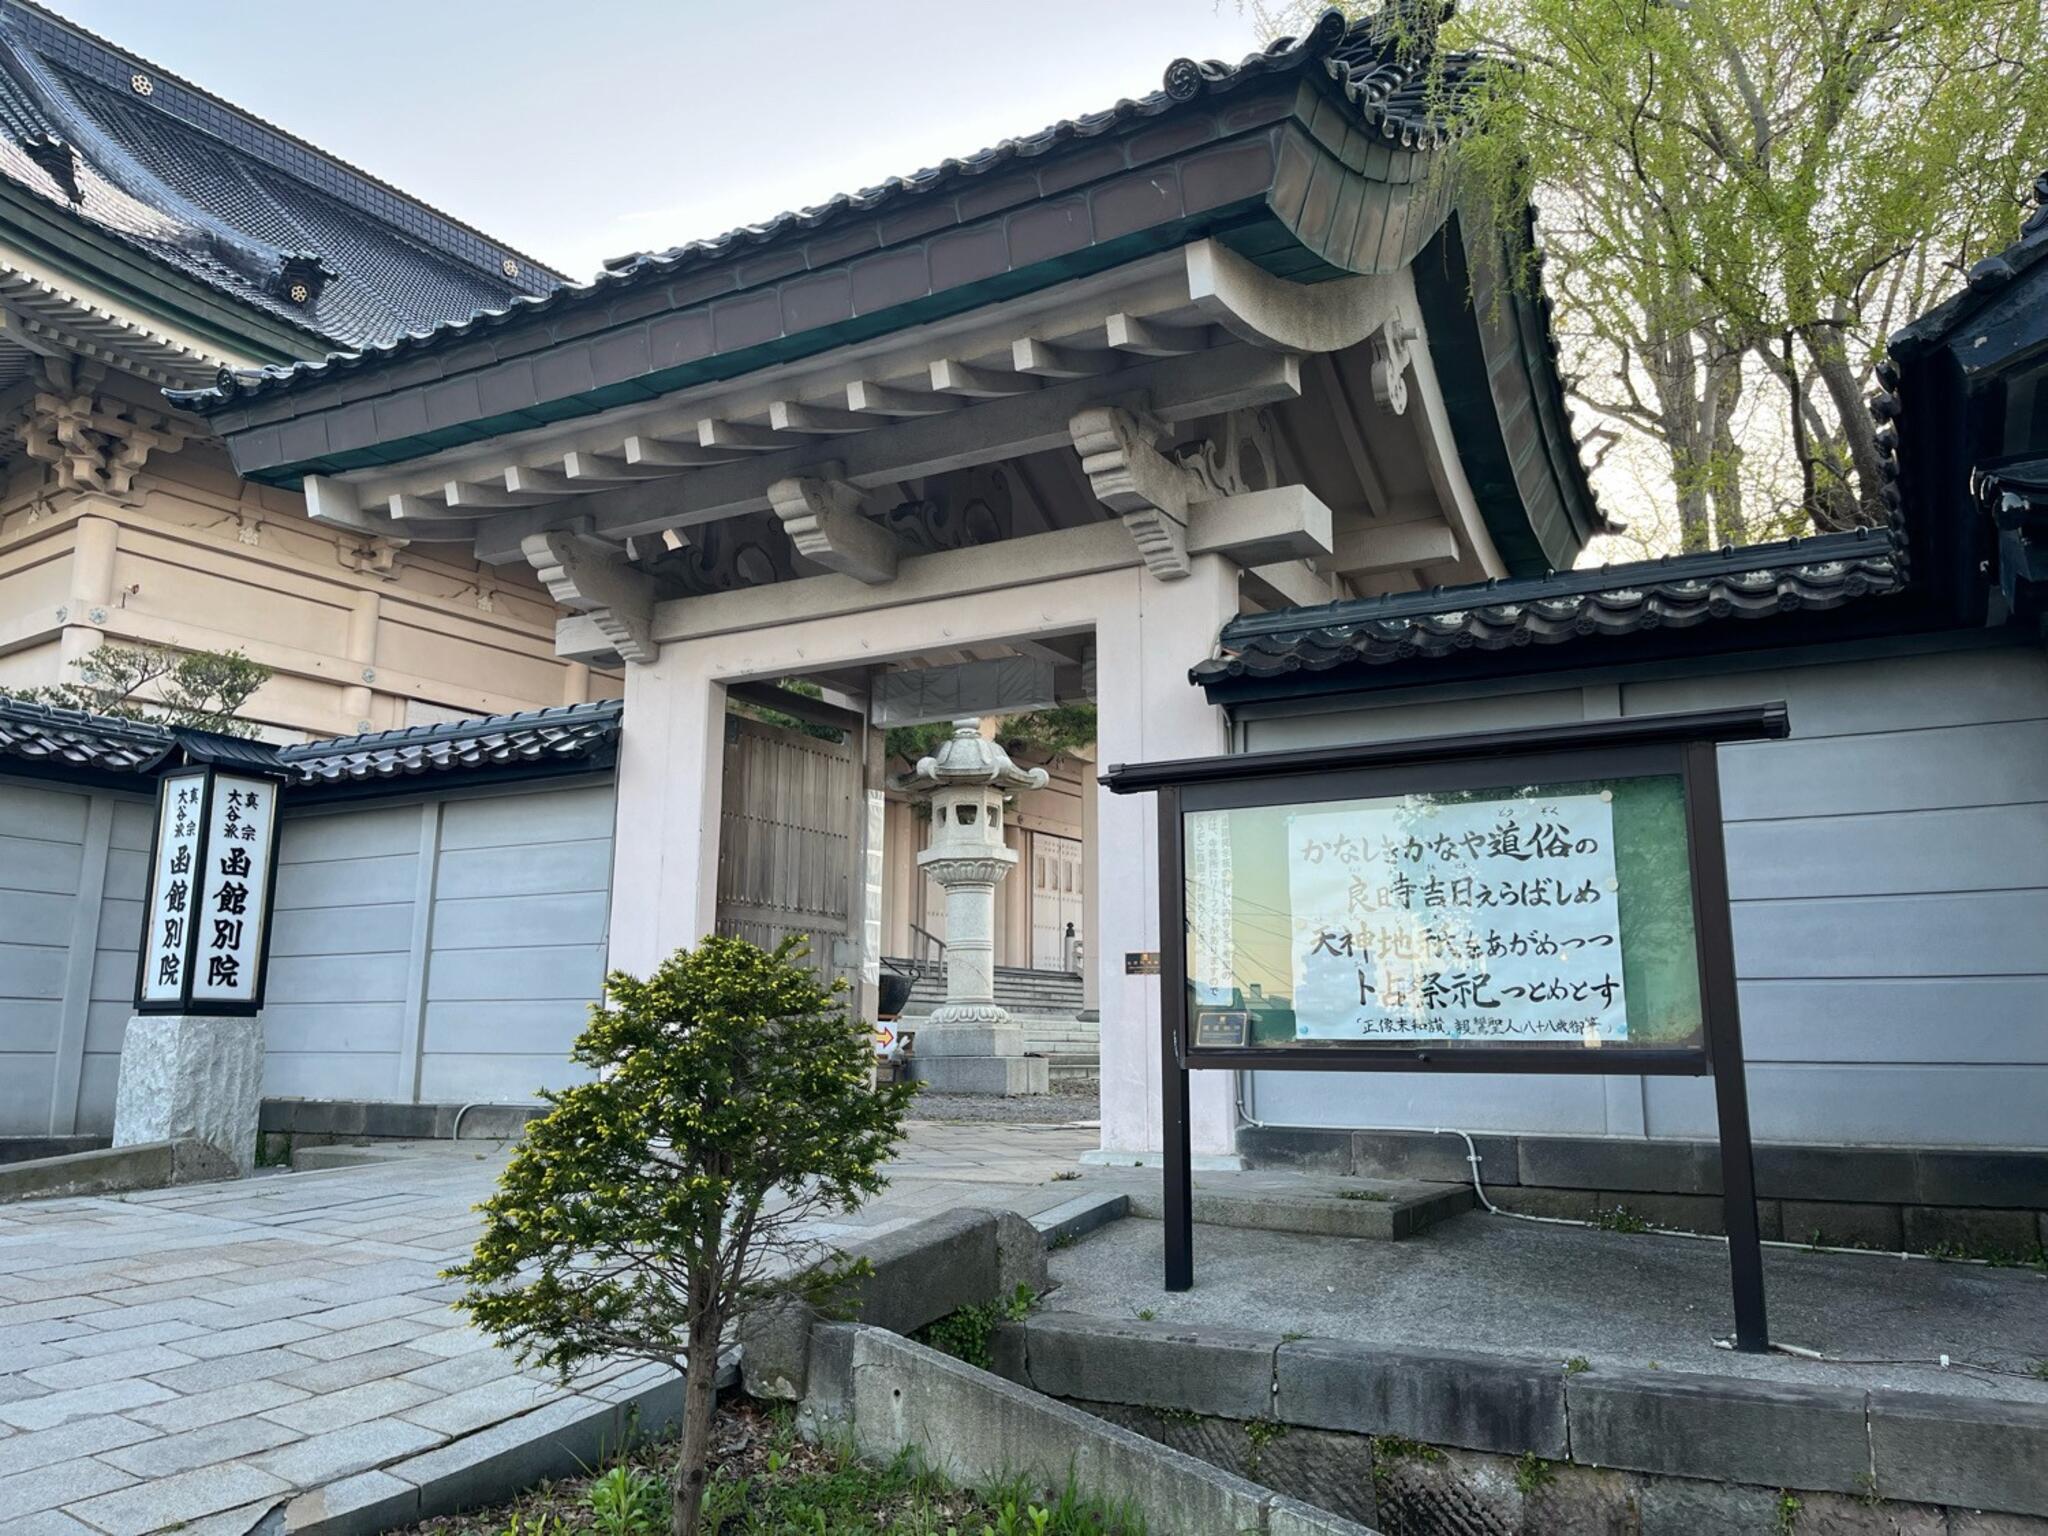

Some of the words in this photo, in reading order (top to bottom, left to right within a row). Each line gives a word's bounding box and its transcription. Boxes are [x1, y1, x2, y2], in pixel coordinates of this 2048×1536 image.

[174, 788, 188, 838] 大谷派
[187, 788, 199, 837] 真宗
[223, 788, 243, 839] 大谷派
[241, 793, 260, 841] 真宗
[1301, 820, 1598, 864] かなしきかなや道俗の
[158, 845, 191, 986] 函館別院
[207, 847, 252, 987] 函館別院
[1347, 872, 1601, 913] 良時吉日えらばしめ
